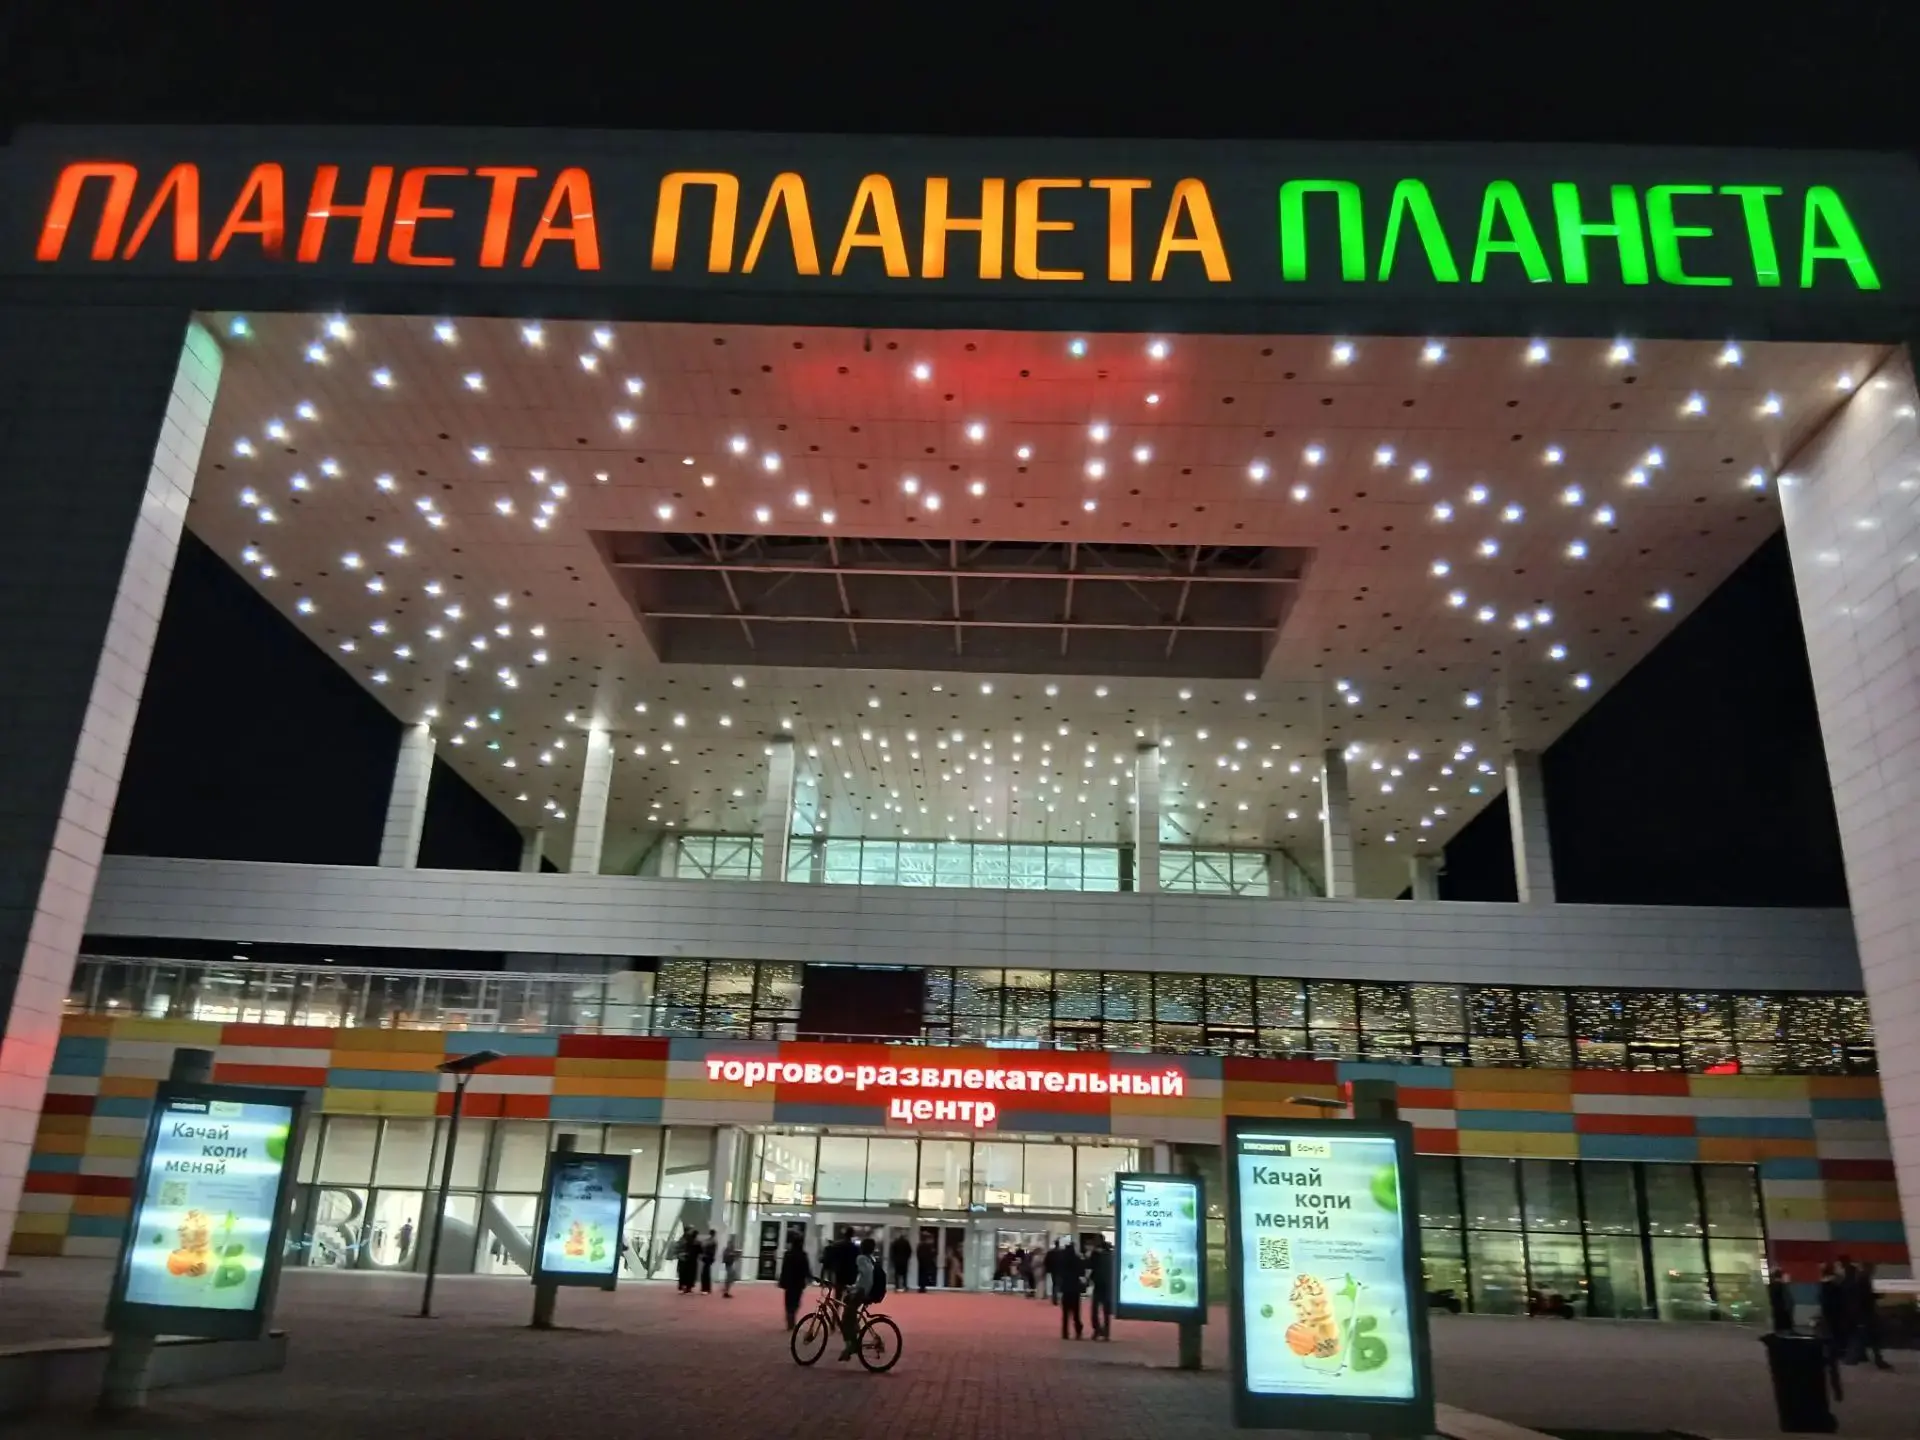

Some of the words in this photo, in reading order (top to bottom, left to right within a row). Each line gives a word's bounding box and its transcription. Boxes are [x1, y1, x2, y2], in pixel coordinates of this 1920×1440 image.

[36, 161, 600, 270] ПЛАНЕТА
[651, 171, 1232, 281] ПЛАНЕТА
[1279, 178, 1881, 289] ПЛАНЕТА
[706, 1059, 1185, 1097] торгово-развлекательный
[889, 1097, 997, 1127] центр
[172, 1122, 230, 1140] Качай
[202, 1144, 248, 1159] копи
[165, 1159, 226, 1175] меняй
[1252, 1166, 1322, 1187] Качай
[1295, 1193, 1351, 1209] копи
[1255, 1211, 1329, 1229] меняй
